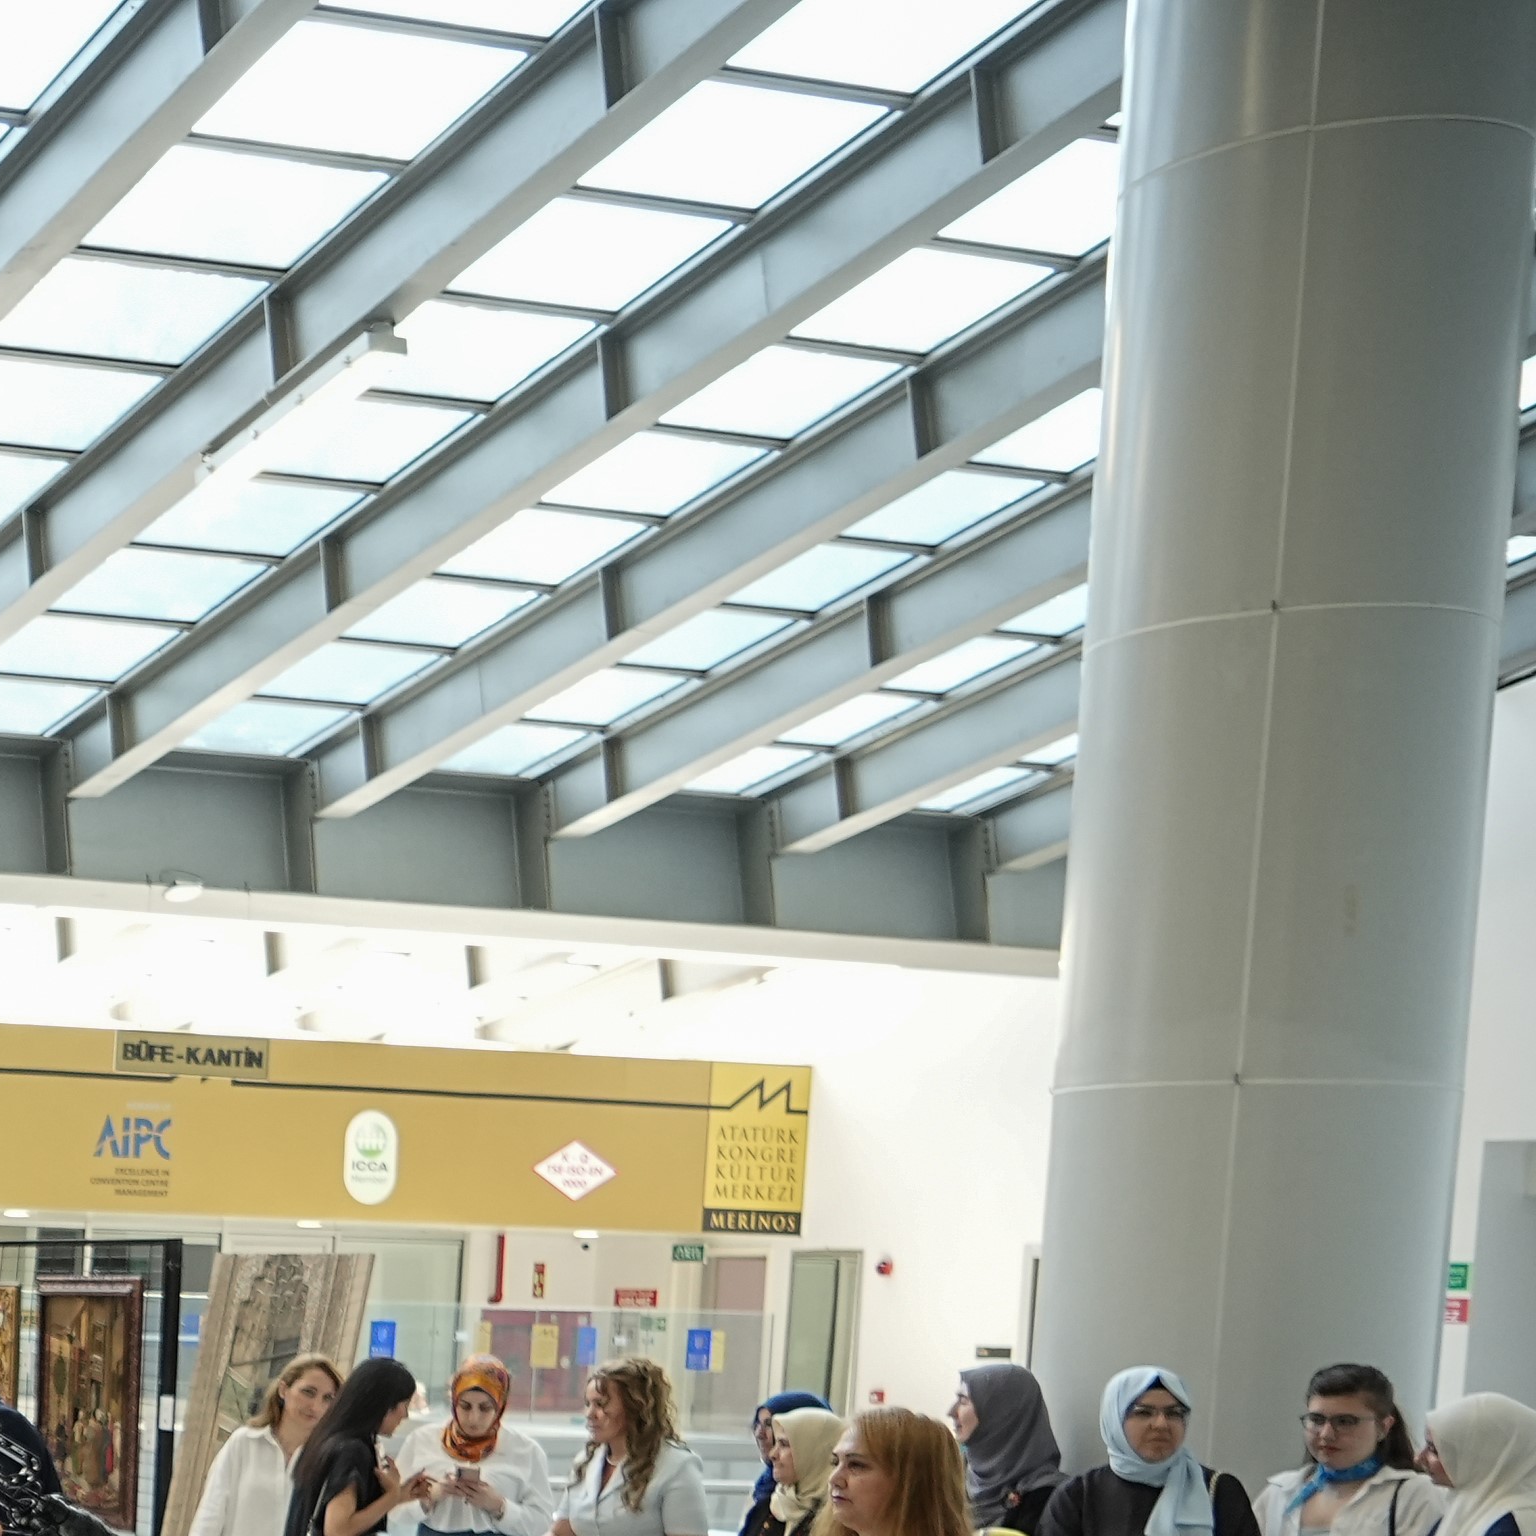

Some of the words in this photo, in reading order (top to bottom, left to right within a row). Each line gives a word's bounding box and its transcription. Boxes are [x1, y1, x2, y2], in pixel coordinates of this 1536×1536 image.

[93, 1114, 171, 1160] AIPC
[716, 1145, 796, 1163] KONGRE
[352, 1160, 388, 1172] ICCA
